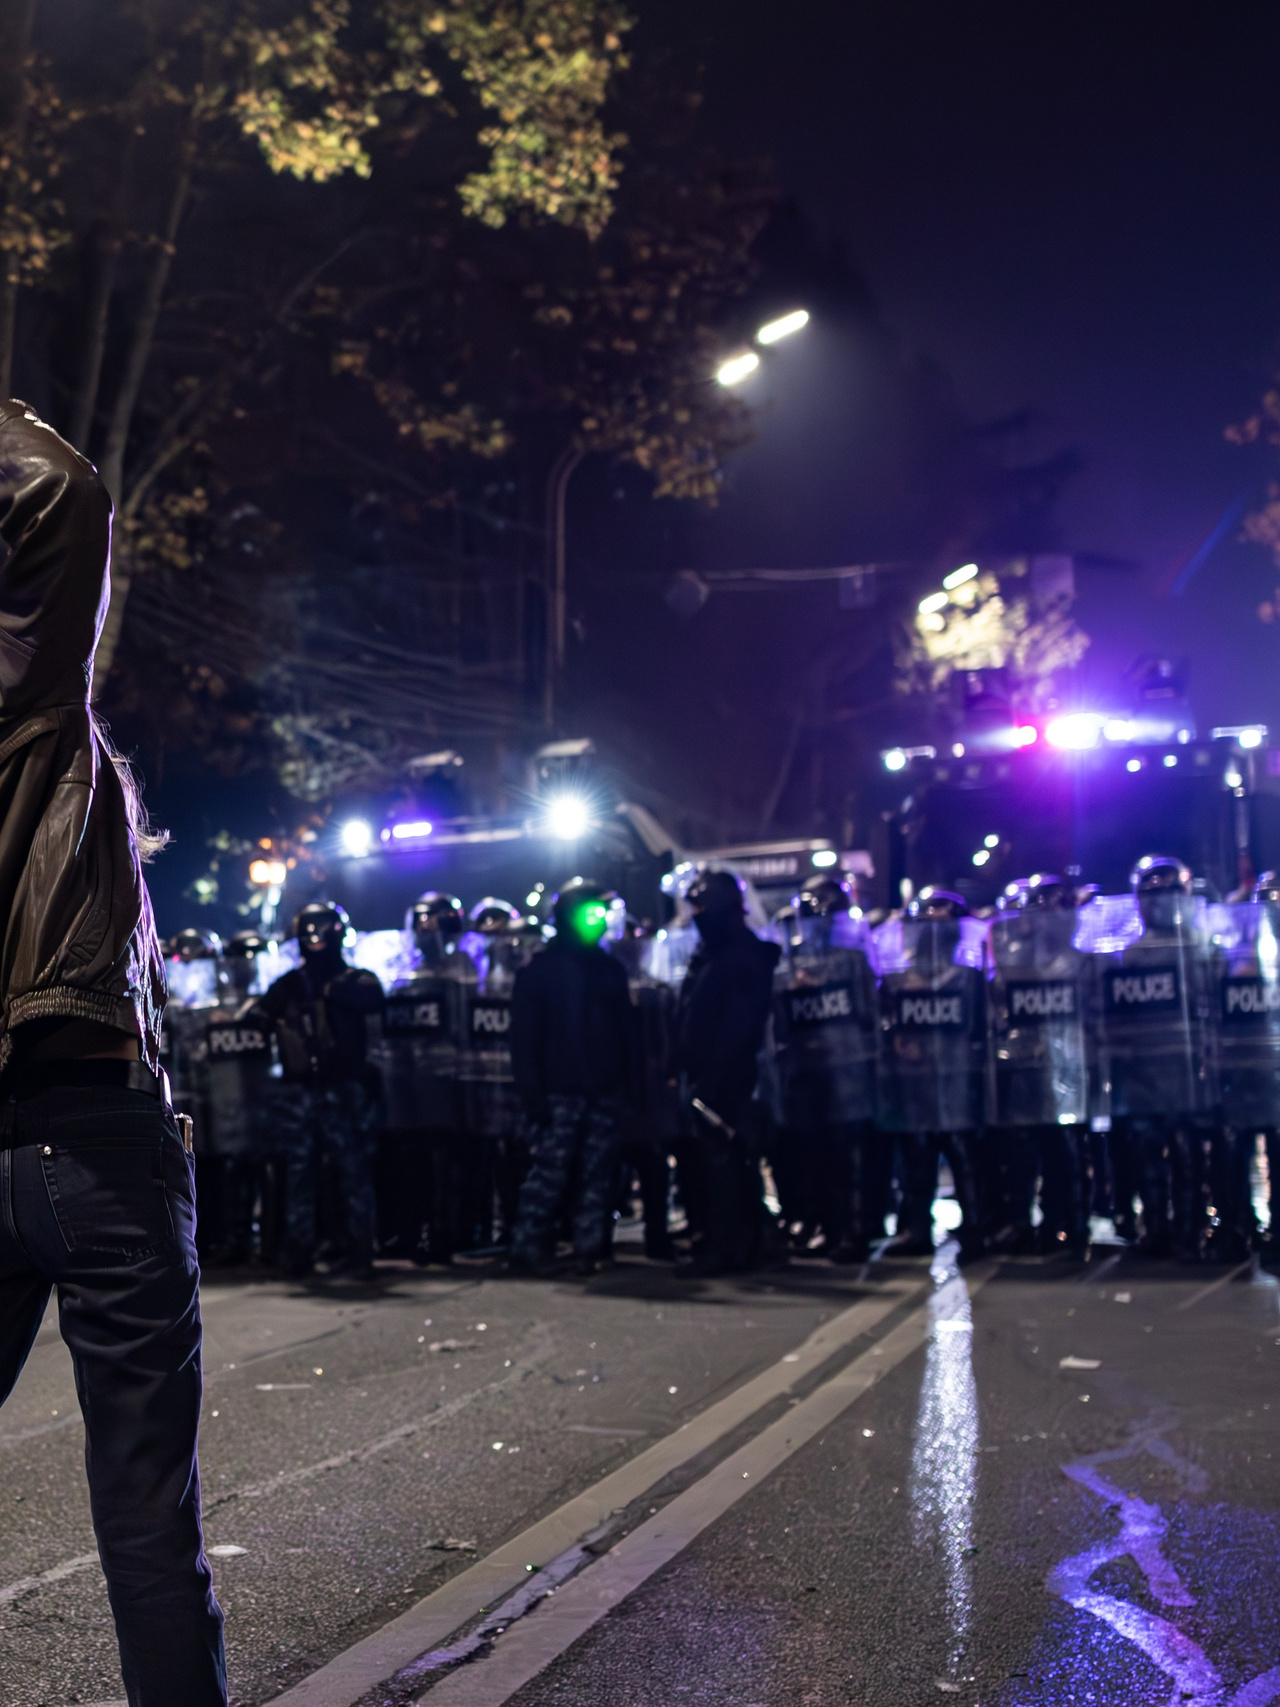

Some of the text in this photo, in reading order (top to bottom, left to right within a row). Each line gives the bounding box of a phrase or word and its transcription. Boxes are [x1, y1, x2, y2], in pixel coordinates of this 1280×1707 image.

[1012, 984, 1074, 1015] POLICE
[1112, 972, 1175, 1003] POLICE
[1226, 984, 1280, 1014] POLIC
[792, 988, 851, 1021] POLICE
[901, 996, 961, 1024] POLICE
[473, 1007, 511, 1033] POLI
[209, 1029, 266, 1054] POLICE
